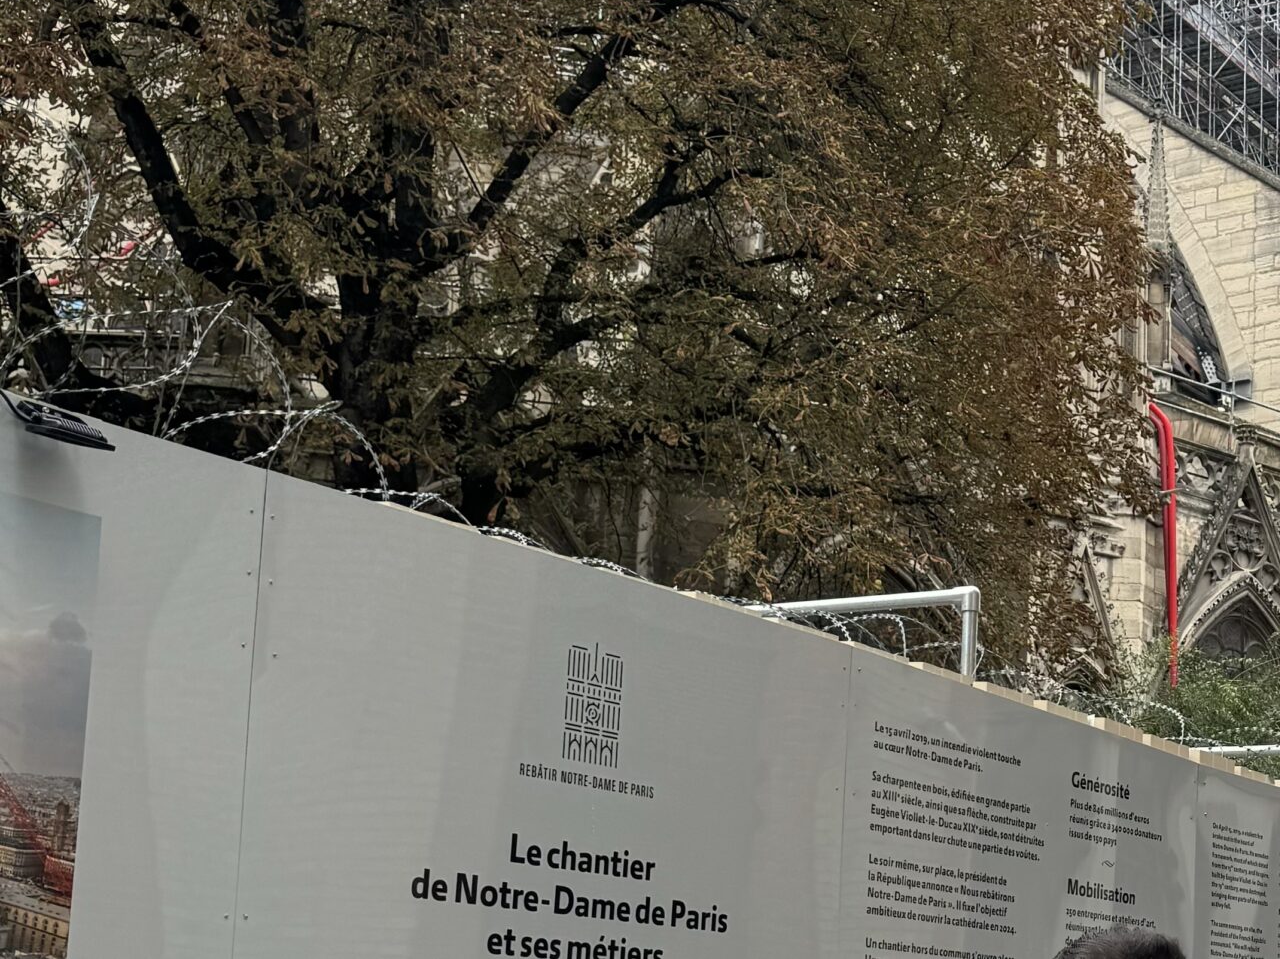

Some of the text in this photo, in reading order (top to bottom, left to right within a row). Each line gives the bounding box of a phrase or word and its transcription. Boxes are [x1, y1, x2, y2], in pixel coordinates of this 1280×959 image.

[873, 740, 984, 773] au cœur Notre-Dame de Paris.
[874, 721, 1022, 767] Le 15 avril 2019, un incendie violent touche
[519, 763, 655, 799] REBÂTIR NOTRE-DAME DE PARIS
[871, 770, 1031, 814] Sa charpente en bois, édifiée en grande partie
[1071, 771, 1131, 800] Générosité
[870, 803, 900, 820] Eugène
[900, 809, 953, 830] Viollet-le-Duc
[952, 822, 962, 831] au
[978, 825, 1000, 840] siècle,
[999, 831, 1015, 842] sont
[1015, 832, 1045, 847] détruites
[871, 789, 882, 799] au
[900, 793, 925, 809] siècle,
[924, 799, 943, 812] ainsi
[943, 804, 958, 816] que
[957, 807, 966, 816] sa
[966, 806, 990, 822] flèche,
[990, 814, 1025, 828] construite
[1024, 821, 1037, 832] par
[509, 833, 656, 882] Le chantier
[869, 823, 1040, 862] emportant dans leur chute une partie des voûtes.
[867, 869, 876, 882] la
[876, 871, 921, 890] République
[921, 881, 954, 894] annonce
[960, 884, 979, 898] Nous
[979, 889, 1015, 903] rebâtirons
[868, 853, 1008, 887] Le soir même, sur place, le président de
[411, 869, 729, 933] de Notre-Dame de Paris
[867, 886, 918, 904] Notre-Dame
[917, 894, 928, 906] de
[928, 895, 947, 909] Paris
[956, 899, 962, 911] Il
[962, 900, 976, 913] fixe
[975, 903, 1008, 918] l'objectif
[1067, 877, 1136, 906] Mobilisation
[866, 905, 1017, 936] ambitieux de rouvrir la cathédrale en 2024.
[487, 929, 664, 959] et ses métiers
[865, 937, 878, 949] Un
[878, 939, 911, 953] chantier
[911, 942, 928, 955] hors
[928, 945, 939, 956] du
[939, 948, 971, 959] commun
